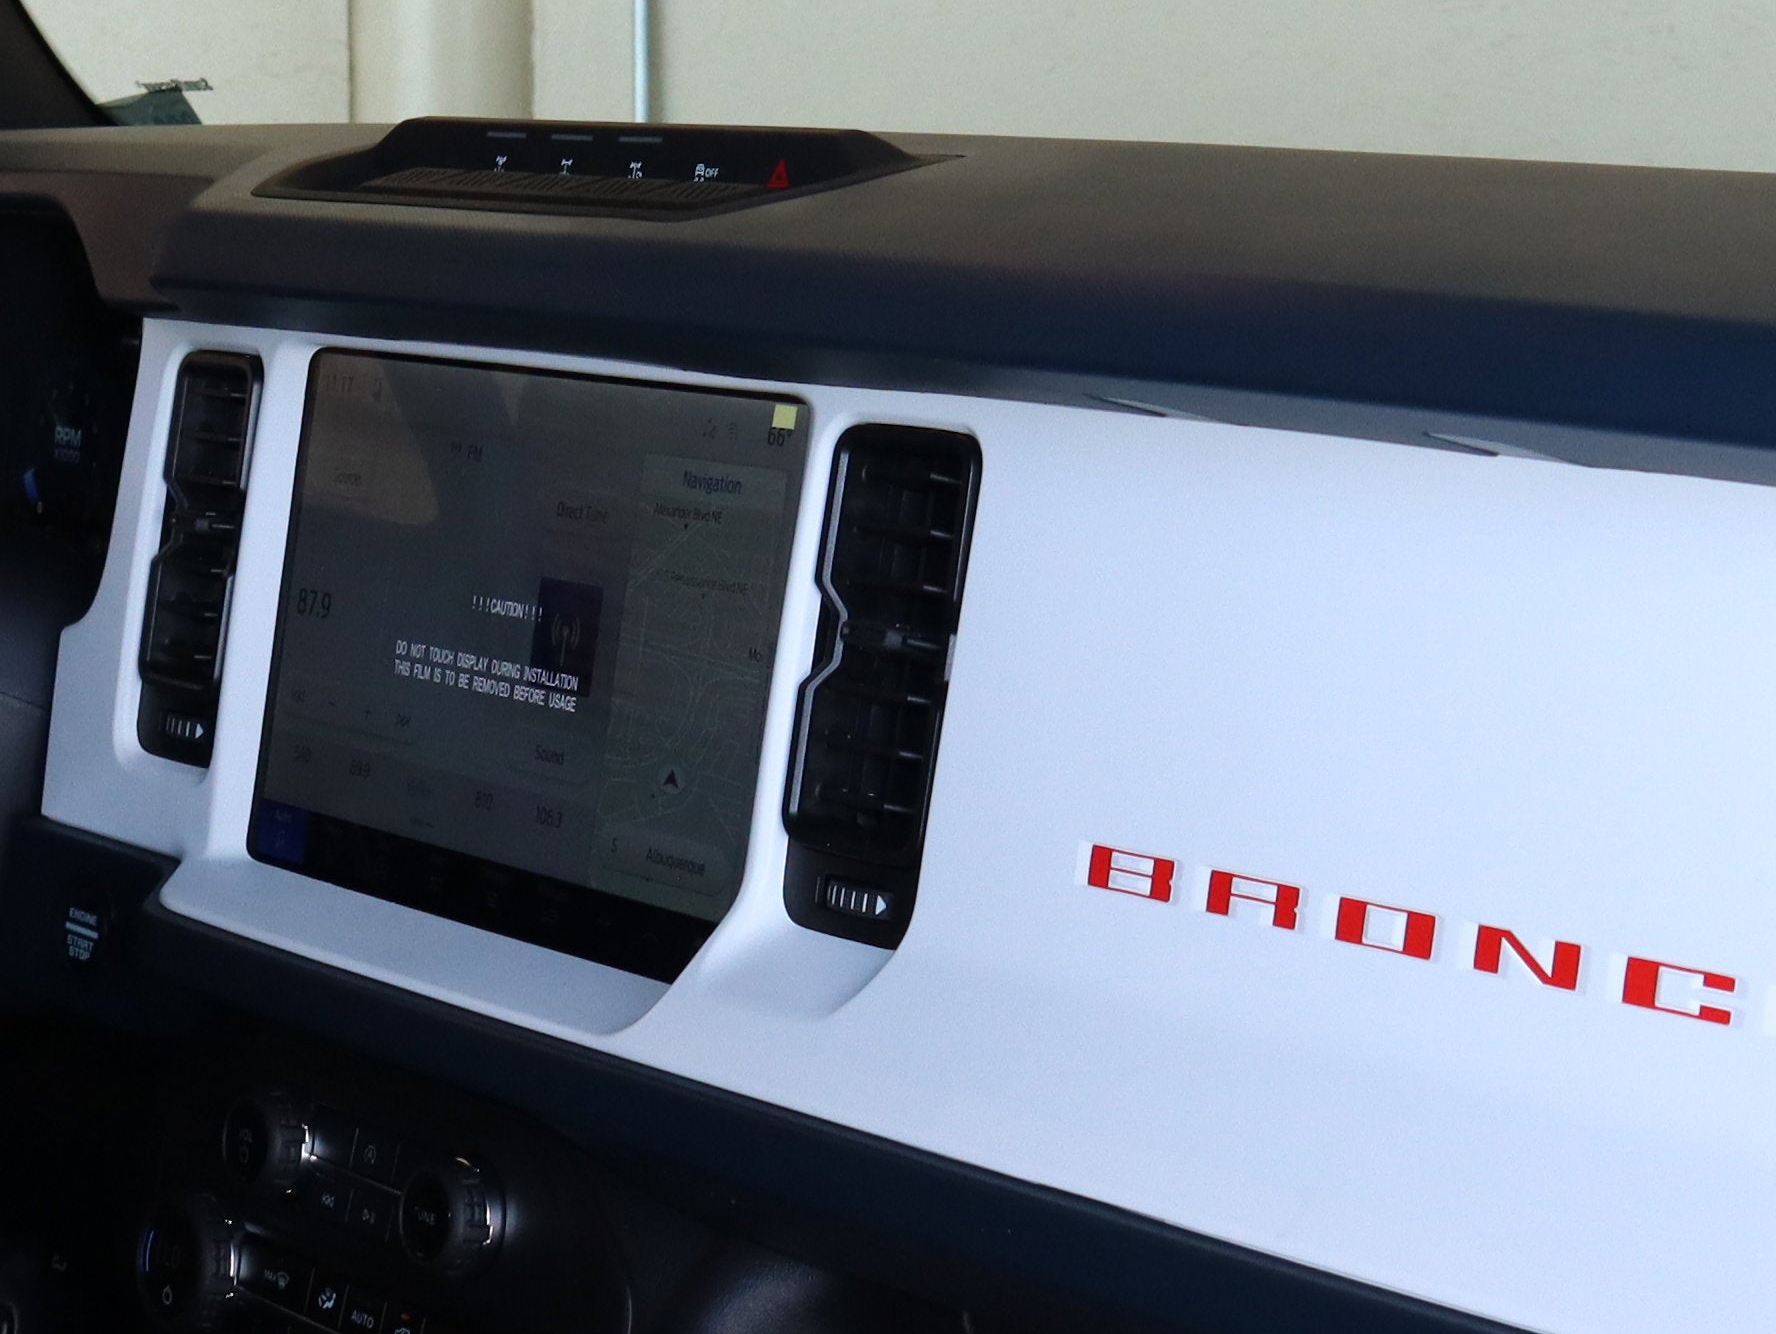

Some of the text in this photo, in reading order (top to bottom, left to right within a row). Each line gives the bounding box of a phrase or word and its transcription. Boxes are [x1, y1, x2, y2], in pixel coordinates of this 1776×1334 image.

[54, 426, 83, 448] RPM
[682, 470, 742, 495] Navigation
[297, 588, 332, 618] 87.9
[395, 640, 579, 691] DO NOT TOUCH DISPLAY DURING INSTALLATION
[394, 659, 577, 713] THIS FILM IS TO BE REMOVED BEFORE USAGE
[66, 933, 95, 952] START
[68, 945, 91, 961] STOP
[350, 1308, 375, 1329] AUTO
